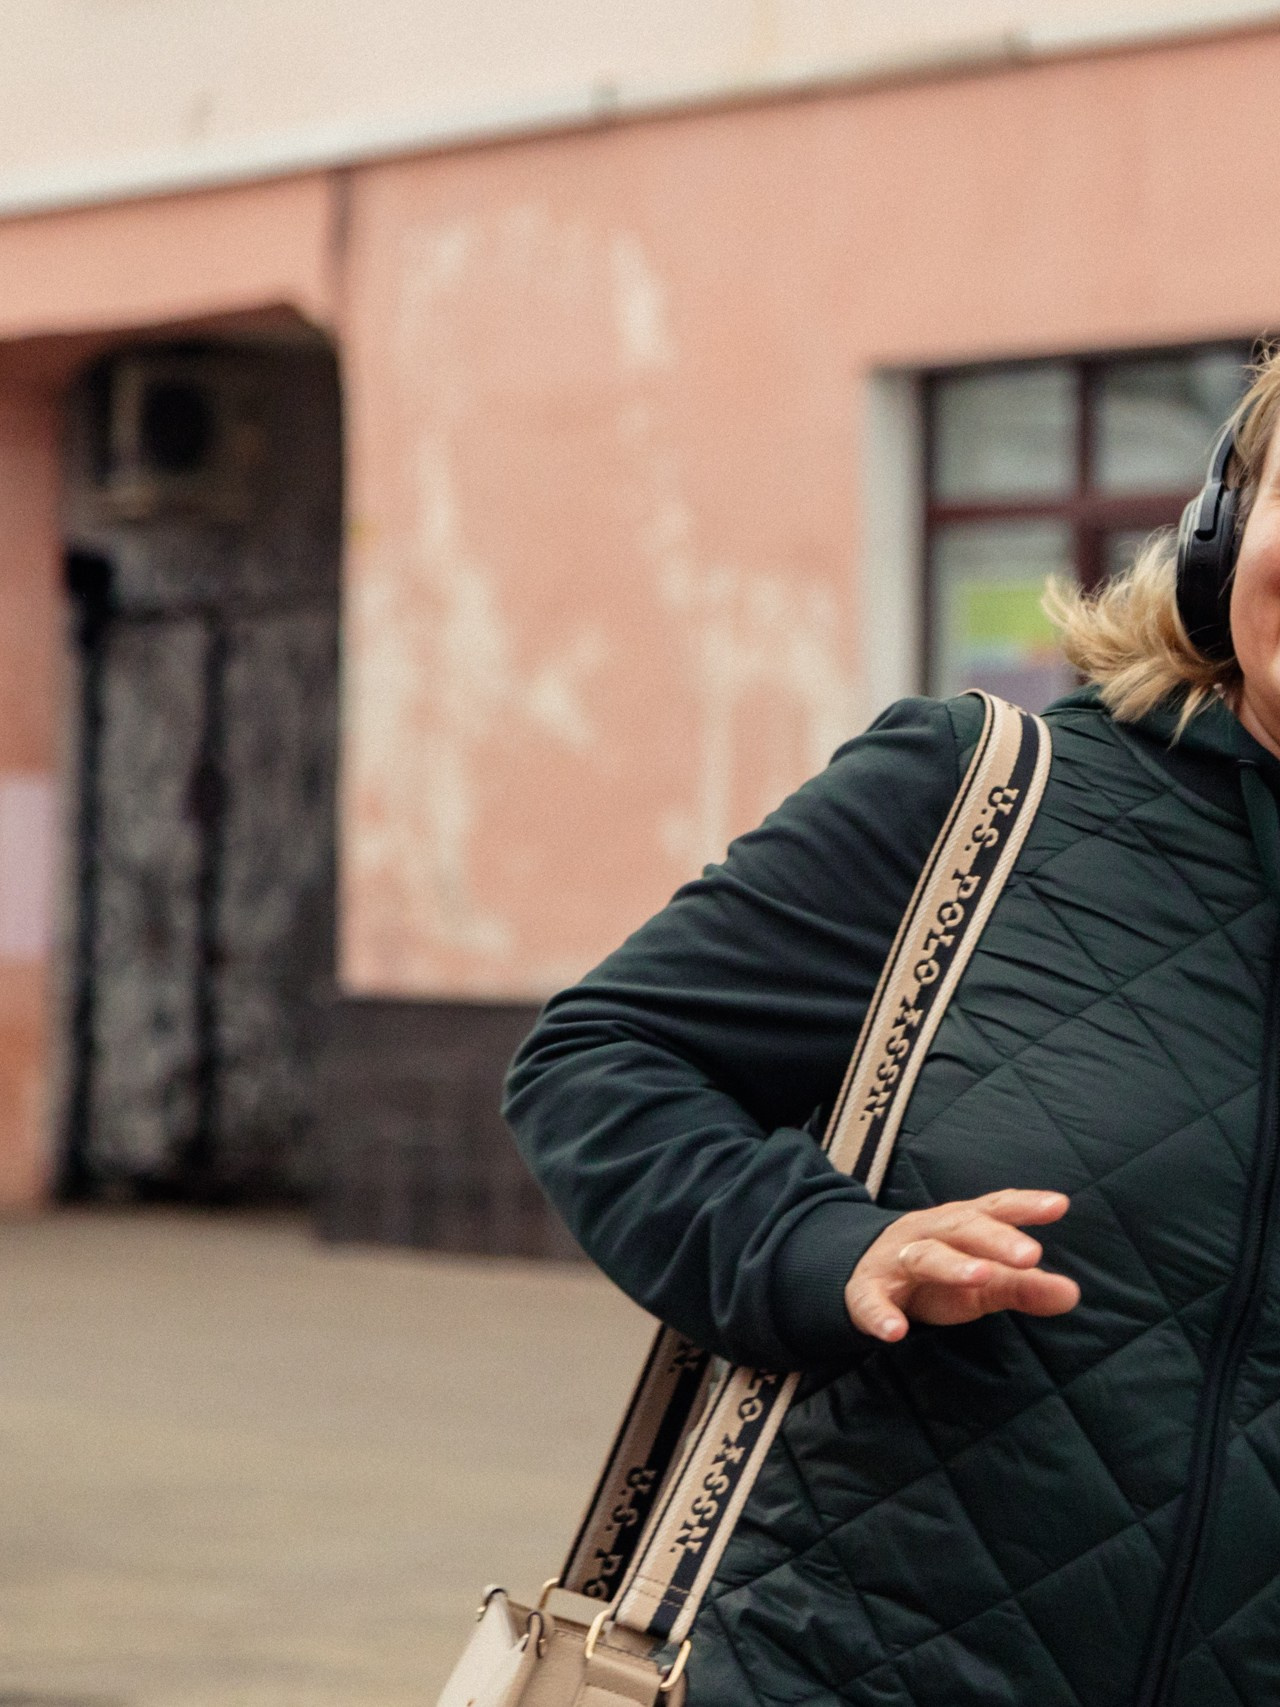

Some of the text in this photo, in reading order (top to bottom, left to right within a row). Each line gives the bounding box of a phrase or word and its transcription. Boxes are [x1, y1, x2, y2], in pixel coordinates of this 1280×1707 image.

[964, 786, 1020, 851] U.S.
[913, 868, 981, 985] POLO
[860, 995, 924, 1121] ASSN.
[604, 1466, 657, 1532] U.S.
[670, 1433, 746, 1555] ASSN.
